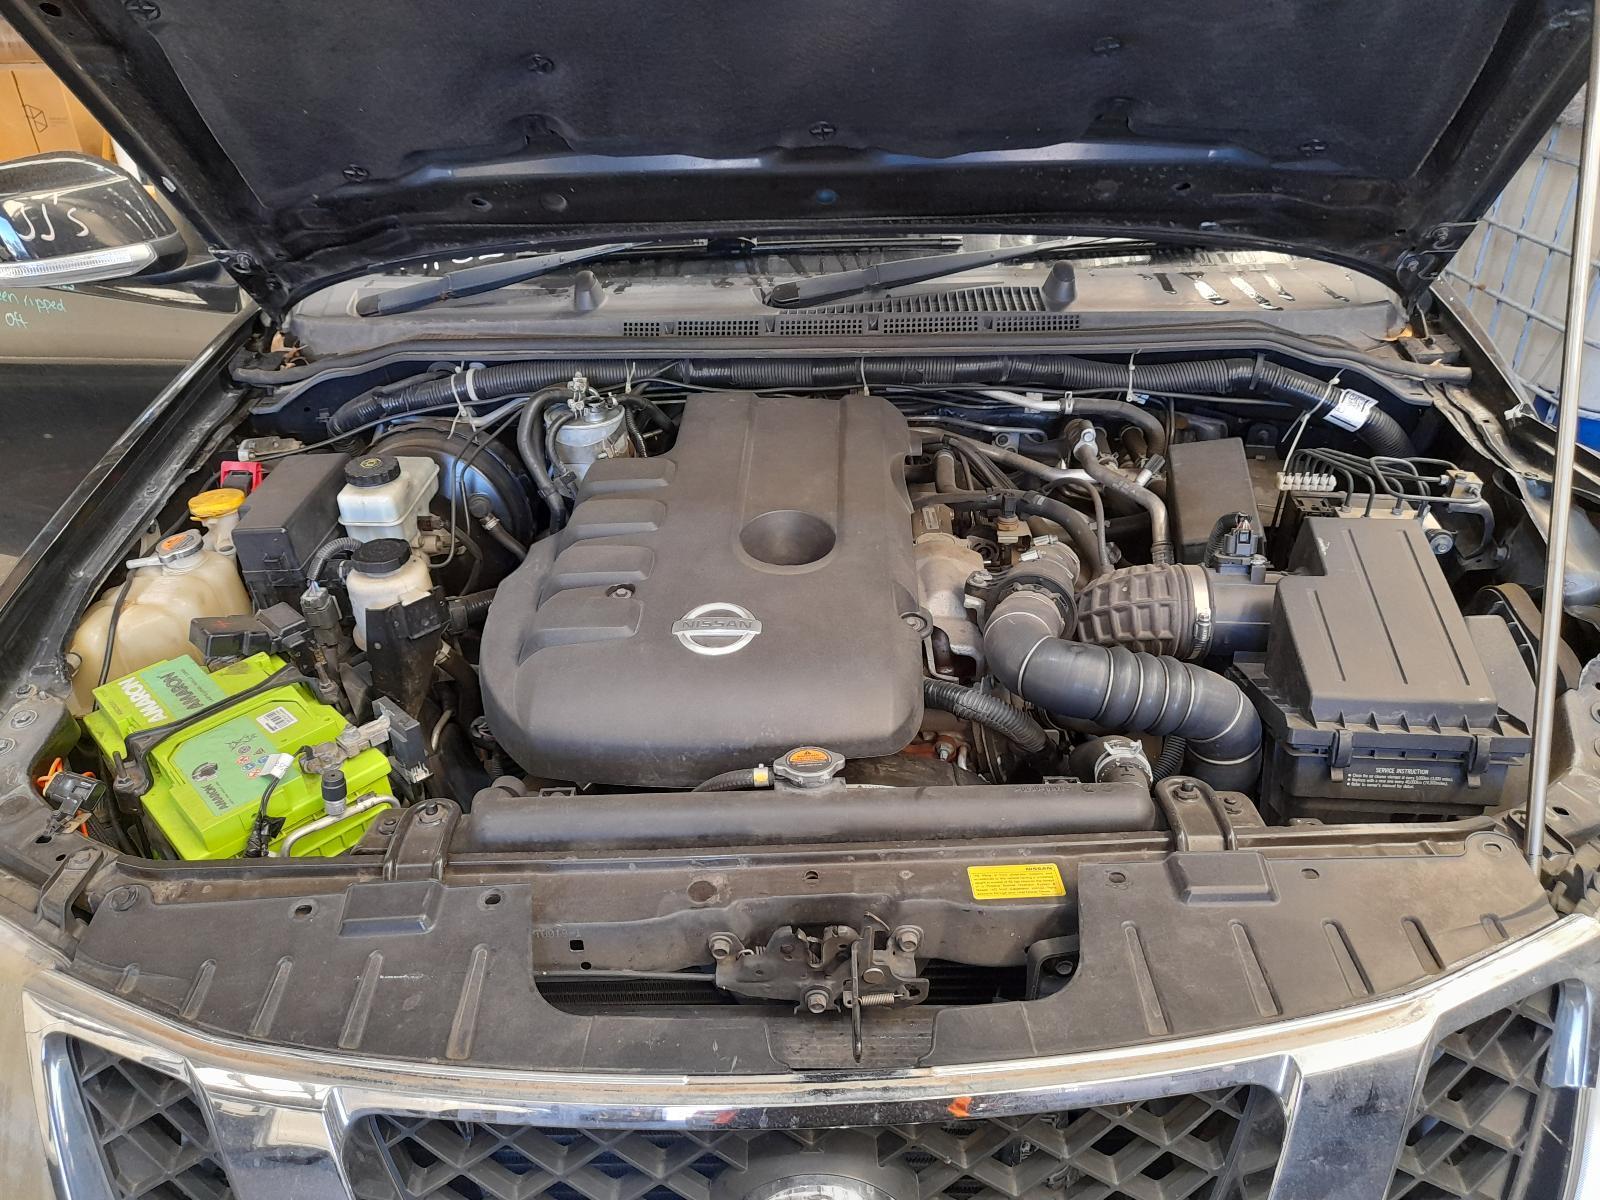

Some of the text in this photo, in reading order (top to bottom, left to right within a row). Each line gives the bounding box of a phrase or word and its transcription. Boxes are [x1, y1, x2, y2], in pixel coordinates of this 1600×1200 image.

[24, 295, 66, 313] ripped
[682, 620, 753, 629] NISSAN
[118, 676, 168, 724] AMARON
[158, 671, 204, 710] AMARON
[1396, 767, 1429, 775] INSTRUCTION
[201, 784, 230, 810] AMARON
